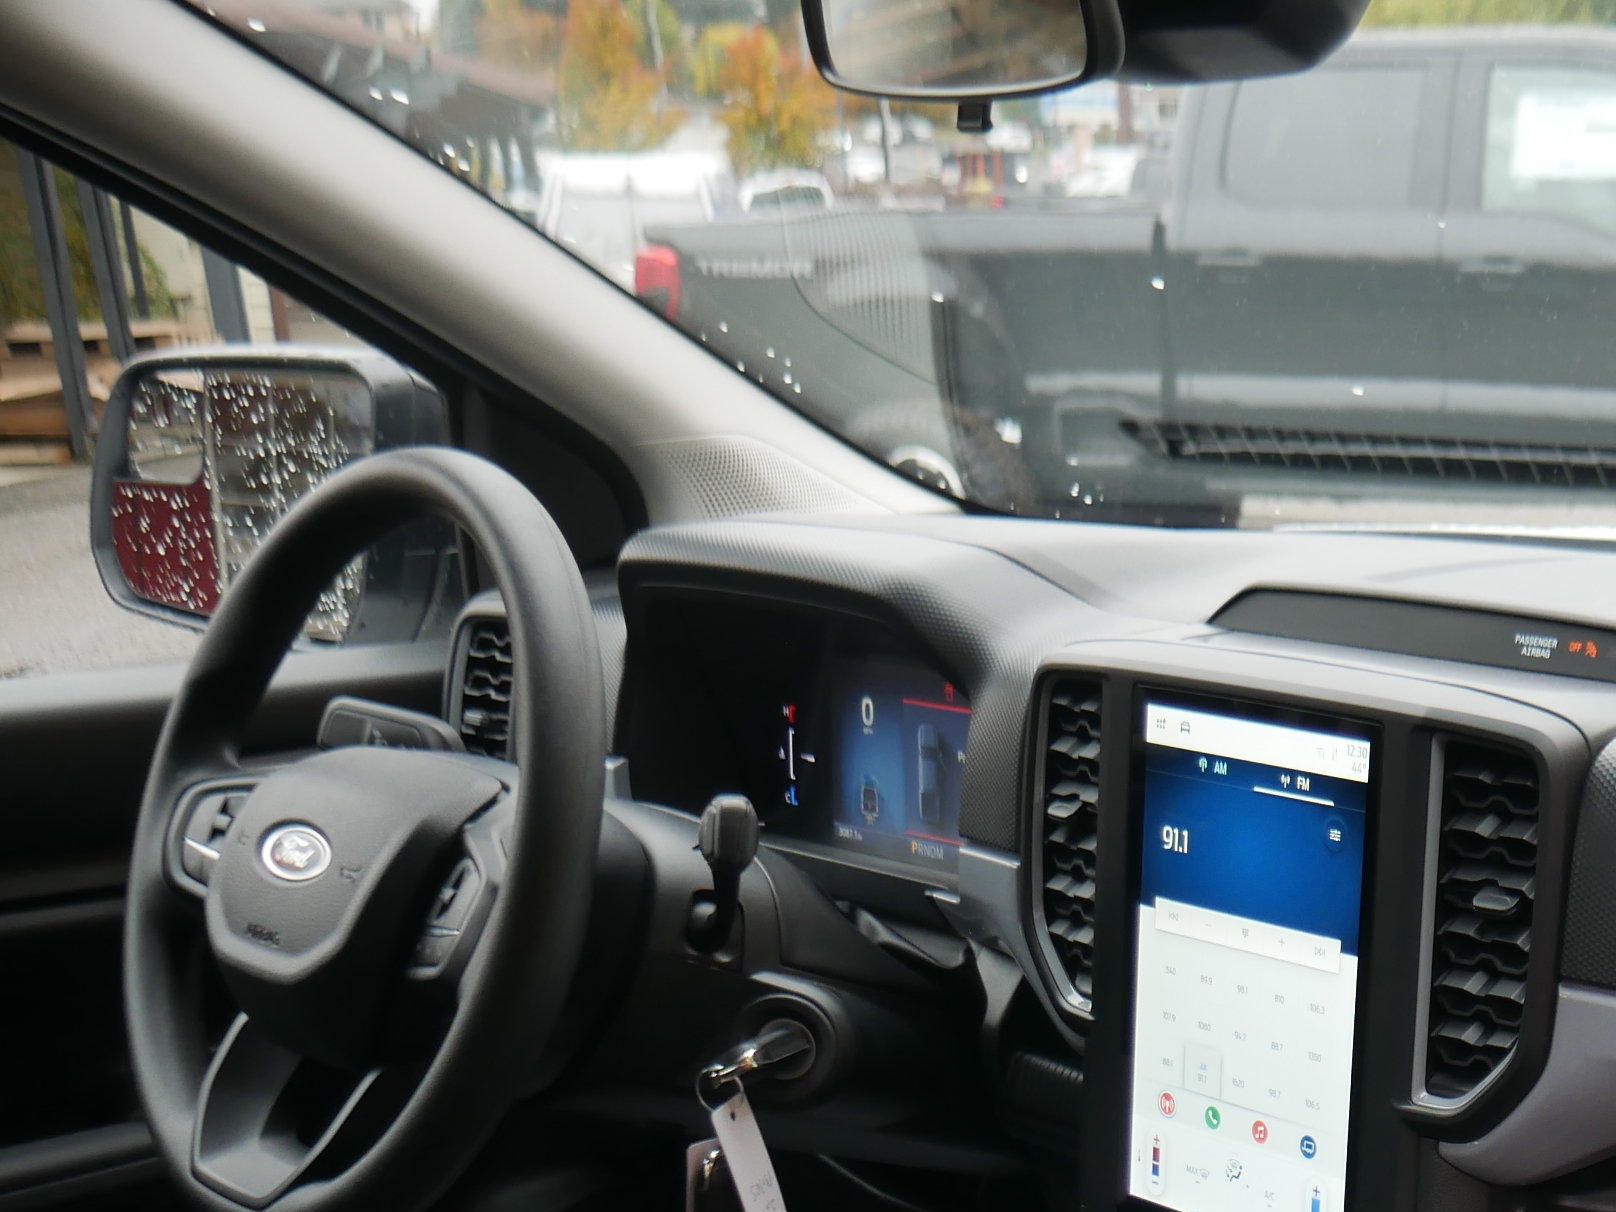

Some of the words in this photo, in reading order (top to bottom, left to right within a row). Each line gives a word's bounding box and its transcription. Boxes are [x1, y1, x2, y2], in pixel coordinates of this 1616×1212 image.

[1515, 634, 1558, 649] PASSENGER
[1568, 641, 1583, 653] OFF
[1521, 647, 1551, 659] AIRBAG
[1214, 761, 1227, 776] AM
[1296, 776, 1310, 792] FM
[1162, 824, 1189, 854] 91.1
